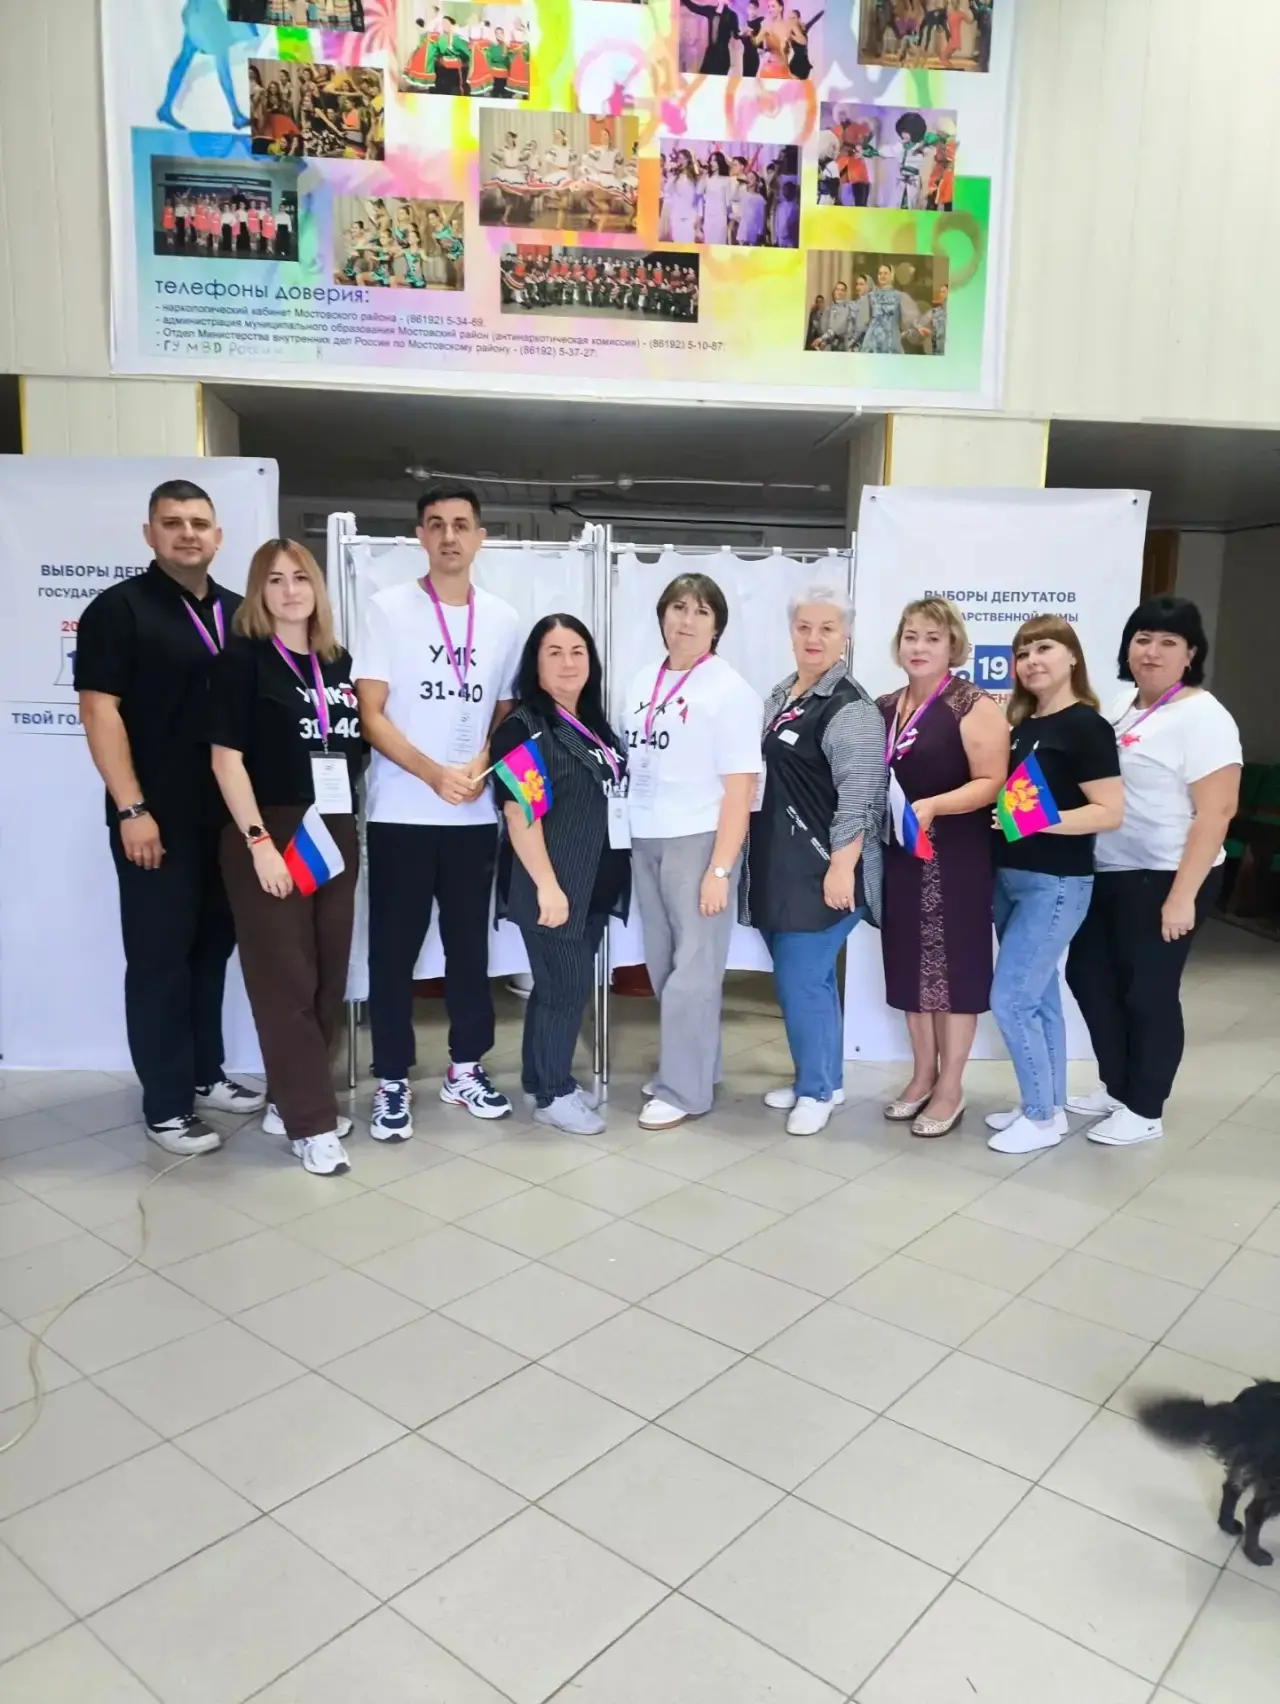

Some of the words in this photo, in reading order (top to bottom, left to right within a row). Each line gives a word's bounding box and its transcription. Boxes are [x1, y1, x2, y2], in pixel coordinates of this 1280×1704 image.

[155, 278, 268, 300] телефоны
[275, 282, 370, 304] доверия:
[251, 306, 291, 317] кабинет
[294, 308, 358, 320] Мостовского
[361, 312, 397, 323] района
[163, 317, 242, 328] администрация
[244, 320, 328, 332] муниципального
[331, 323, 395, 335] образования
[398, 326, 456, 338] Мостовский
[459, 329, 489, 340] район
[163, 327, 196, 338] Отдел
[198, 329, 270, 341] Министерства
[272, 333, 330, 345] внутренних
[333, 336, 352, 346] дел
[354, 336, 391, 348] России
[393, 340, 405, 348] по
[408, 340, 472, 353] Мостовскому
[476, 345, 511, 356] району
[41, 564, 110, 578] ВЫБОРЫ
[924, 590, 988, 602] ВЫБОРЫ
[991, 591, 1077, 604] ДЕПУТАТОВ
[978, 656, 1009, 681] 19
[419, 680, 483, 703] 31-40
[11, 710, 54, 724] ТВОЙ
